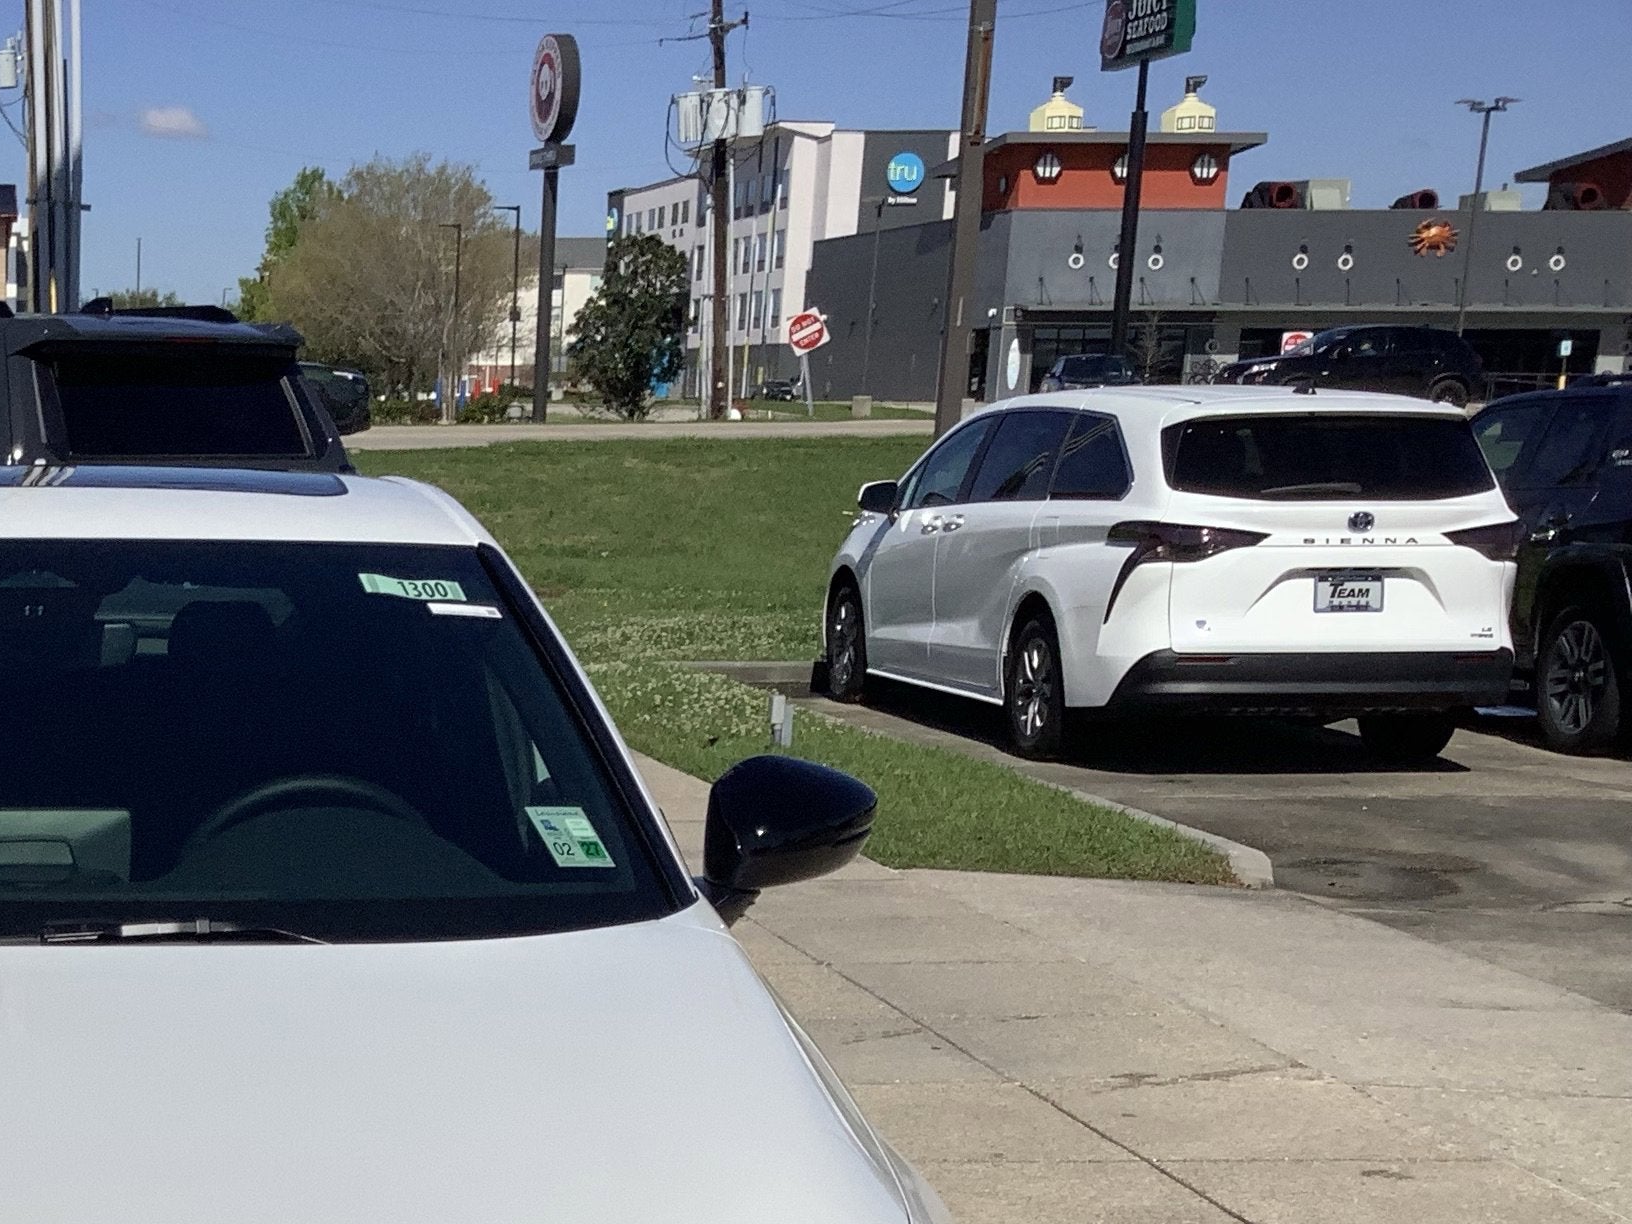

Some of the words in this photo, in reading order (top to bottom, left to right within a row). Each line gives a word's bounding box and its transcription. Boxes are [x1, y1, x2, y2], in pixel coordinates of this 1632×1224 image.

[1126, 12, 1167, 39] SEAFOOD
[888, 161, 917, 181] tru
[397, 581, 448, 598] 1300
[1329, 583, 1371, 599] TEAM
[553, 842, 575, 856] 02
[581, 842, 601, 856] 27
